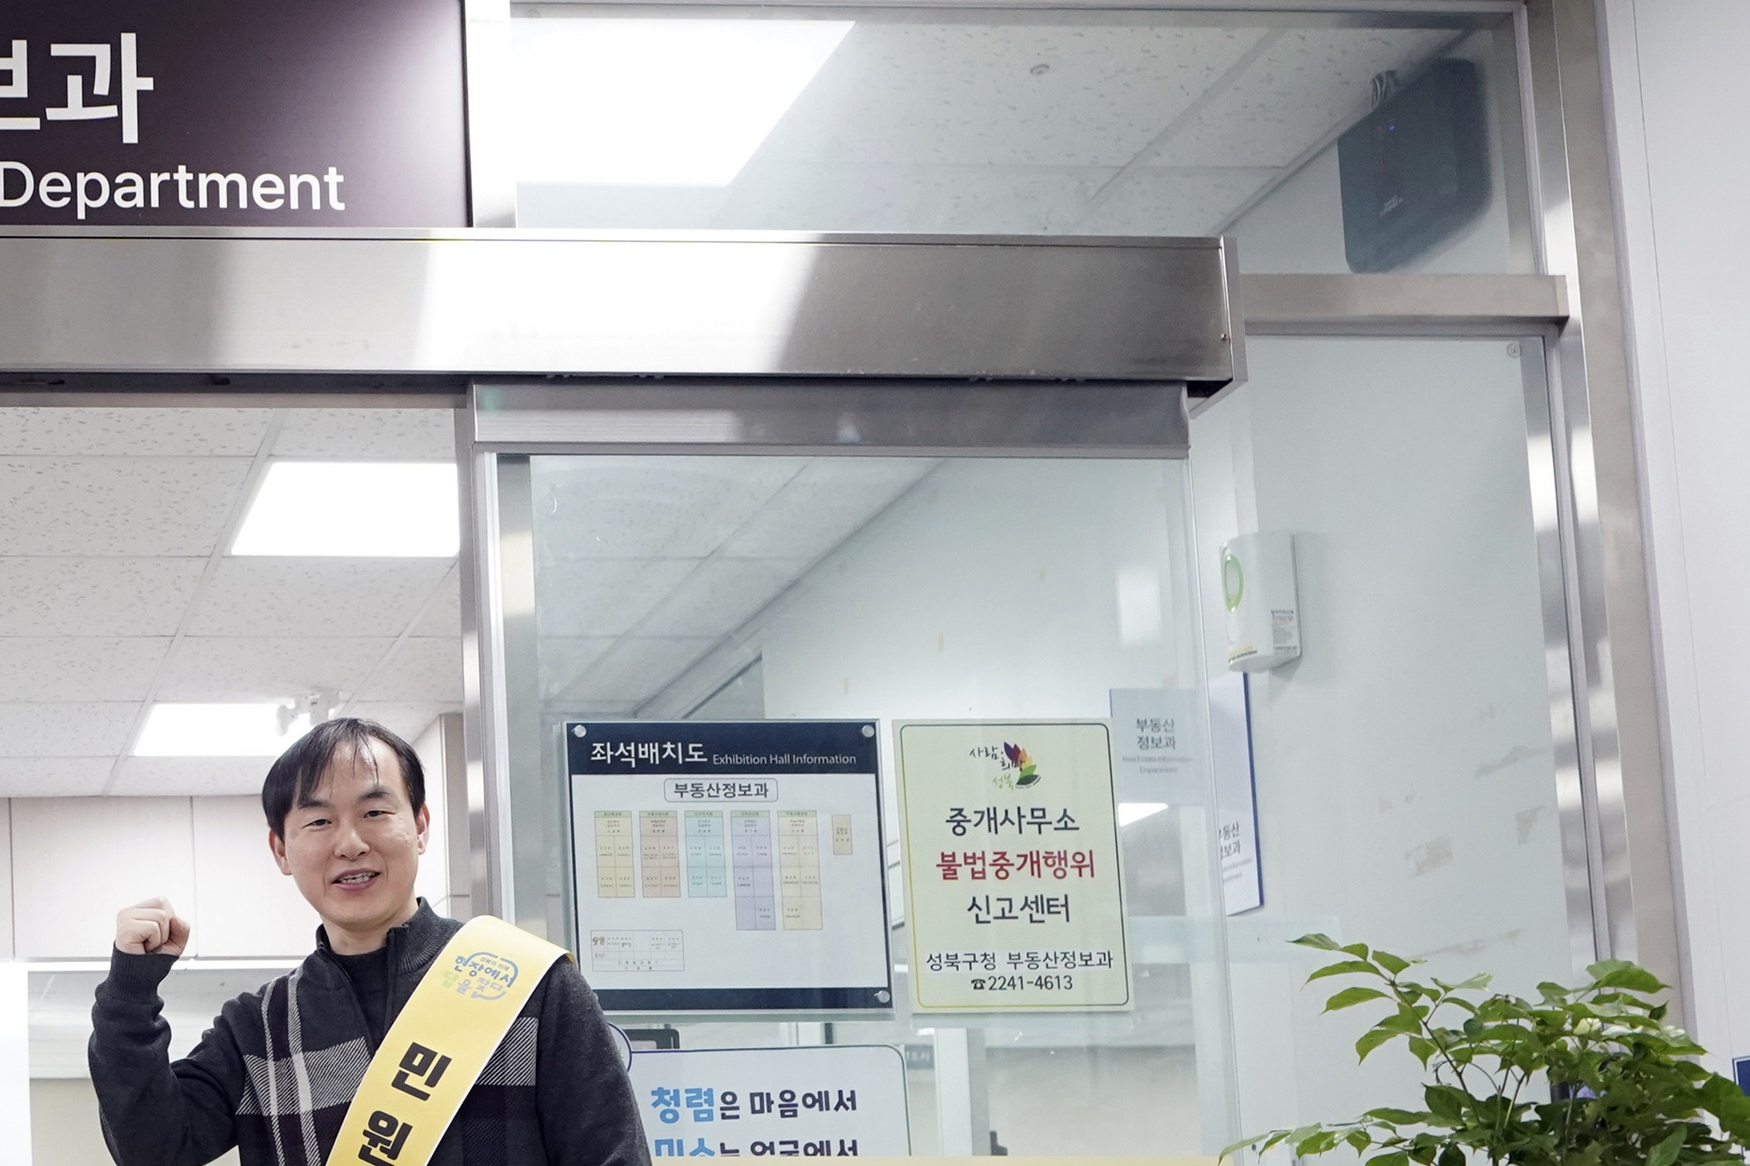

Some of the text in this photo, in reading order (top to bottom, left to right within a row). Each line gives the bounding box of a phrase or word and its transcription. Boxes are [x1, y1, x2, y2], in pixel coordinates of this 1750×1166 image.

[1136, 718, 1175, 733] 부동산
[590, 741, 857, 768] 좌석배치도 Exhibition Hall Information
[1136, 735, 1176, 750] 정보과
[673, 782, 769, 798] 부동산정보과
[945, 805, 1080, 837] 중개사무소
[936, 849, 1095, 881] 불법중개행위
[967, 894, 1071, 925] 신고센터
[926, 950, 1114, 972] 성북구청 부동산정보과
[650, 1086, 858, 1124] 청렴은 마음에서
